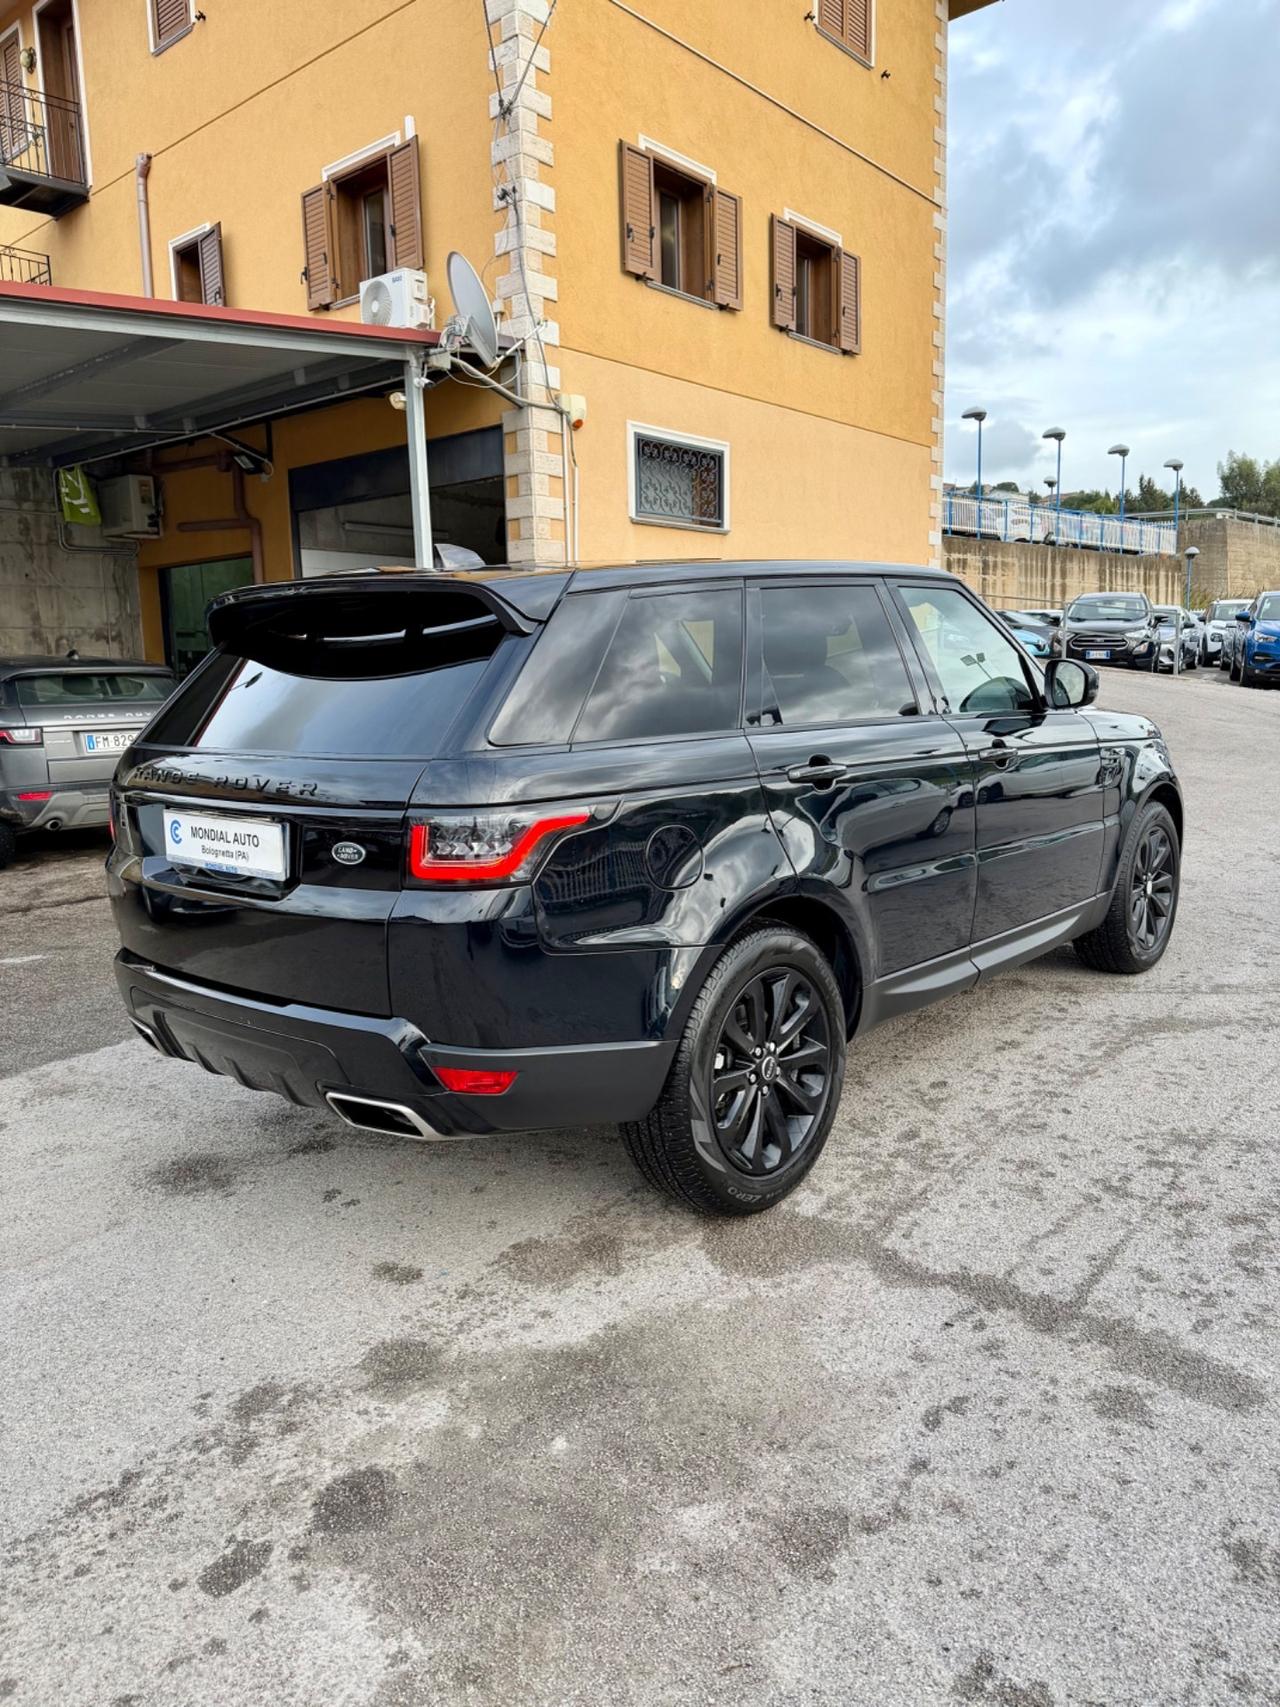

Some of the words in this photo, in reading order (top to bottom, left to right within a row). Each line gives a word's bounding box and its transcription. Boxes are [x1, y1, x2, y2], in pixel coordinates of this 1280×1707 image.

[95, 735, 110, 748] FM
[214, 776, 318, 796] ROVER
[190, 825, 232, 844] MONDIAL
[233, 832, 260, 848] AUTO
[201, 844, 234, 859] Bolognetta
[234, 850, 249, 861] (PA)
[727, 1186, 762, 1203] ZERO
